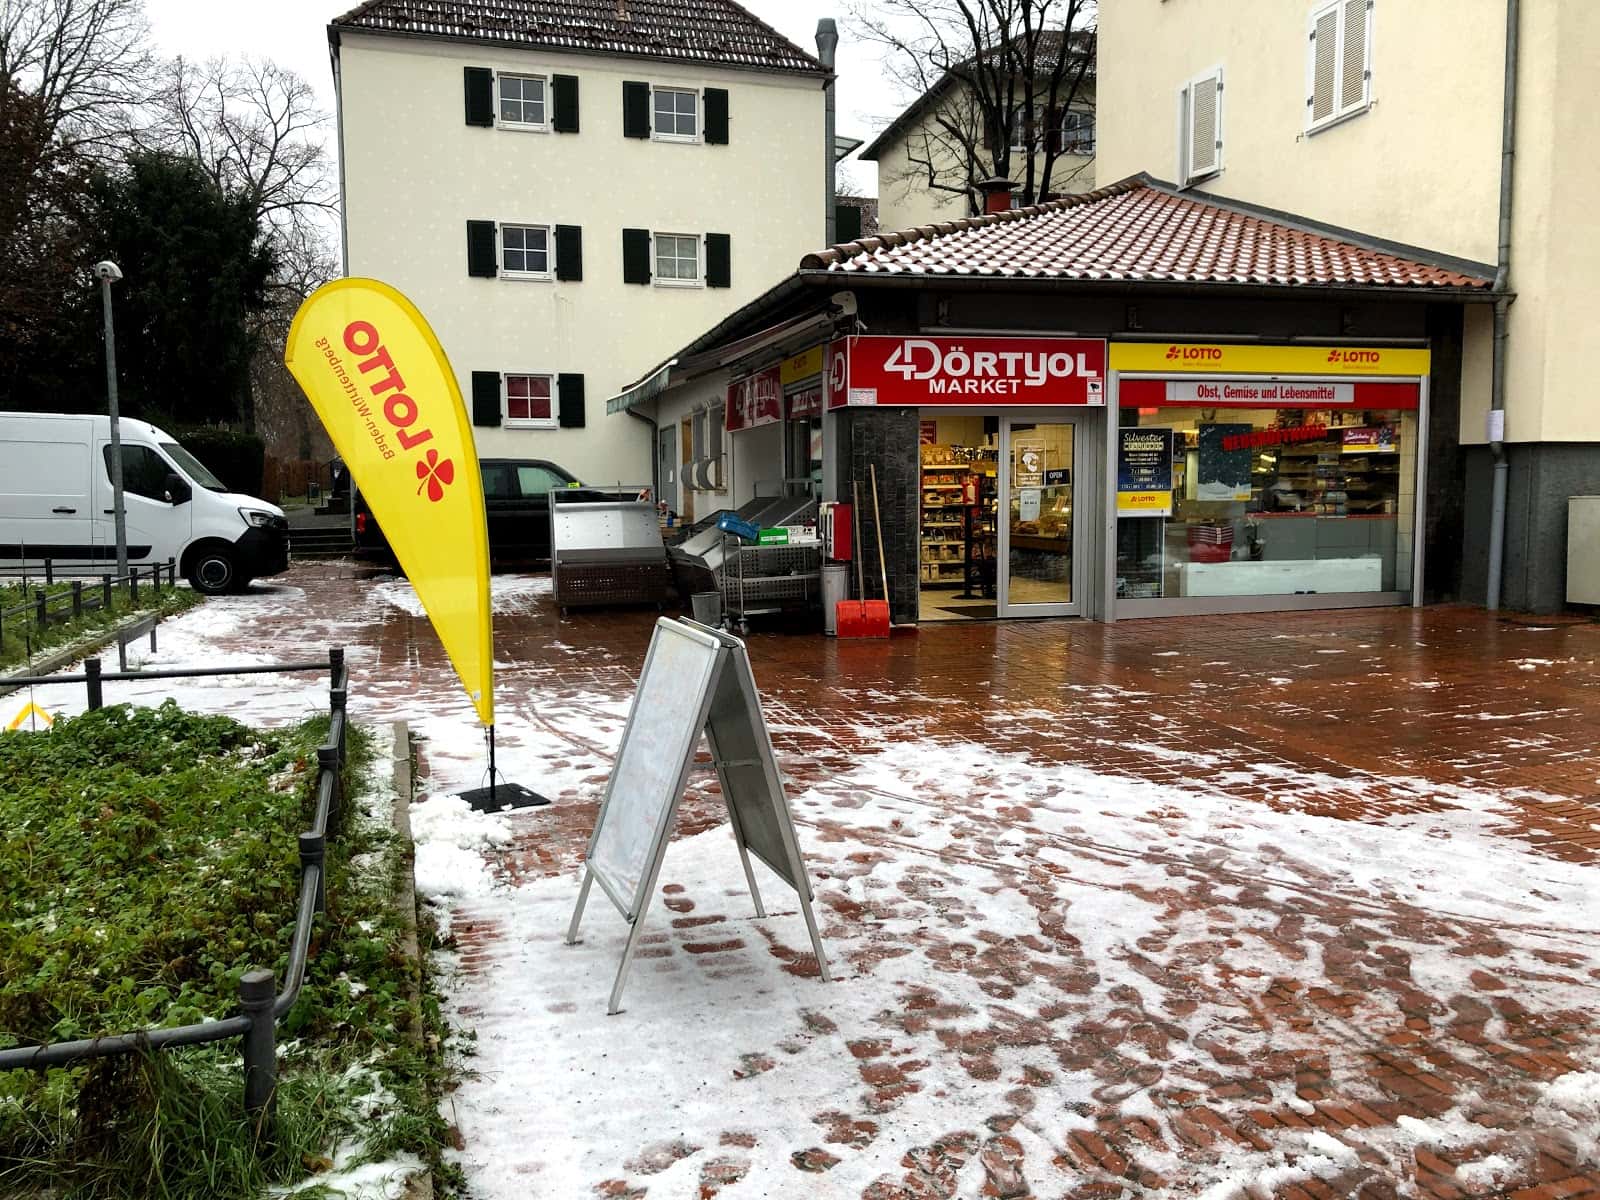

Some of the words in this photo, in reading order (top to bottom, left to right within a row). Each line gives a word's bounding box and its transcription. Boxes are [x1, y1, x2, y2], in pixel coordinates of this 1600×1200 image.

[1183, 347, 1222, 360] LOTTO
[1343, 351, 1380, 363] LOTTO
[929, 379, 1022, 394] MARKET
[1197, 385, 1220, 400] Obst,
[1223, 384, 1258, 400] Gemüse
[1261, 385, 1277, 399] und
[1280, 385, 1335, 400] Lebensmittel
